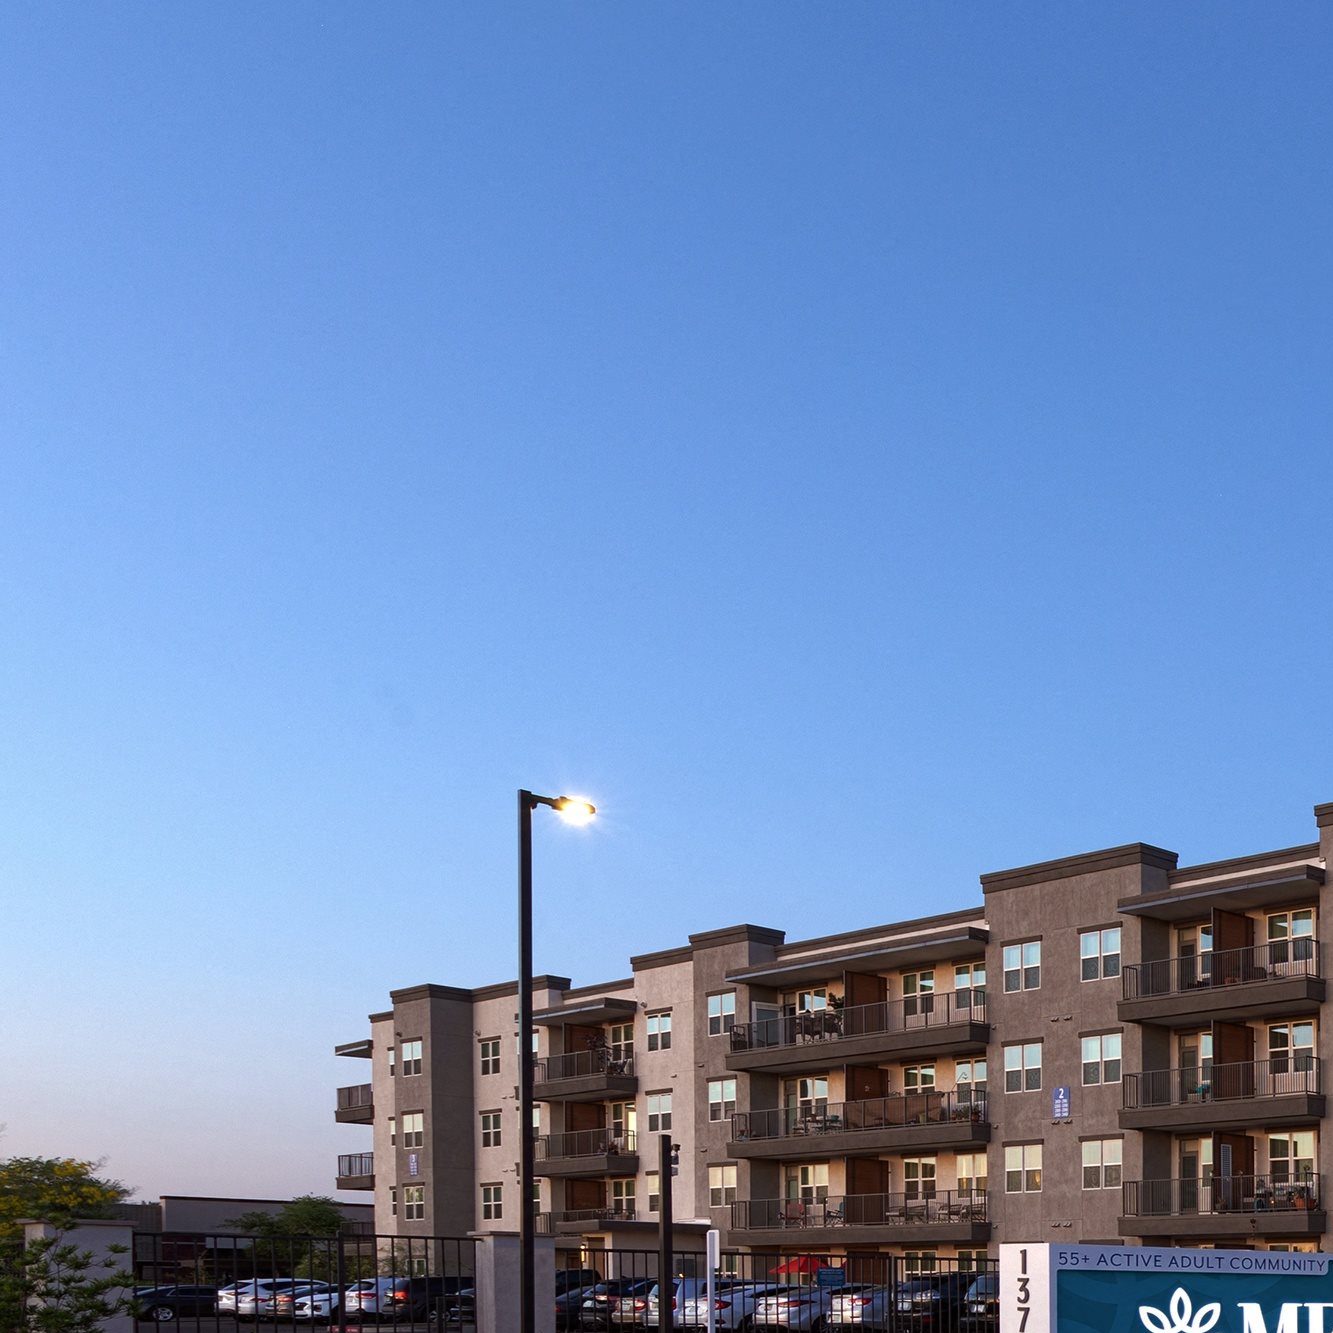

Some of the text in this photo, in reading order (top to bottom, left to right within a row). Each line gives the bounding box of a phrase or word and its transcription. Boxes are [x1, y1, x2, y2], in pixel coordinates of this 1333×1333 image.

[1058, 1088, 1065, 1099] 2
[1058, 1251, 1326, 1272] 55+ ACTIVE ADULT COMMUNITY
